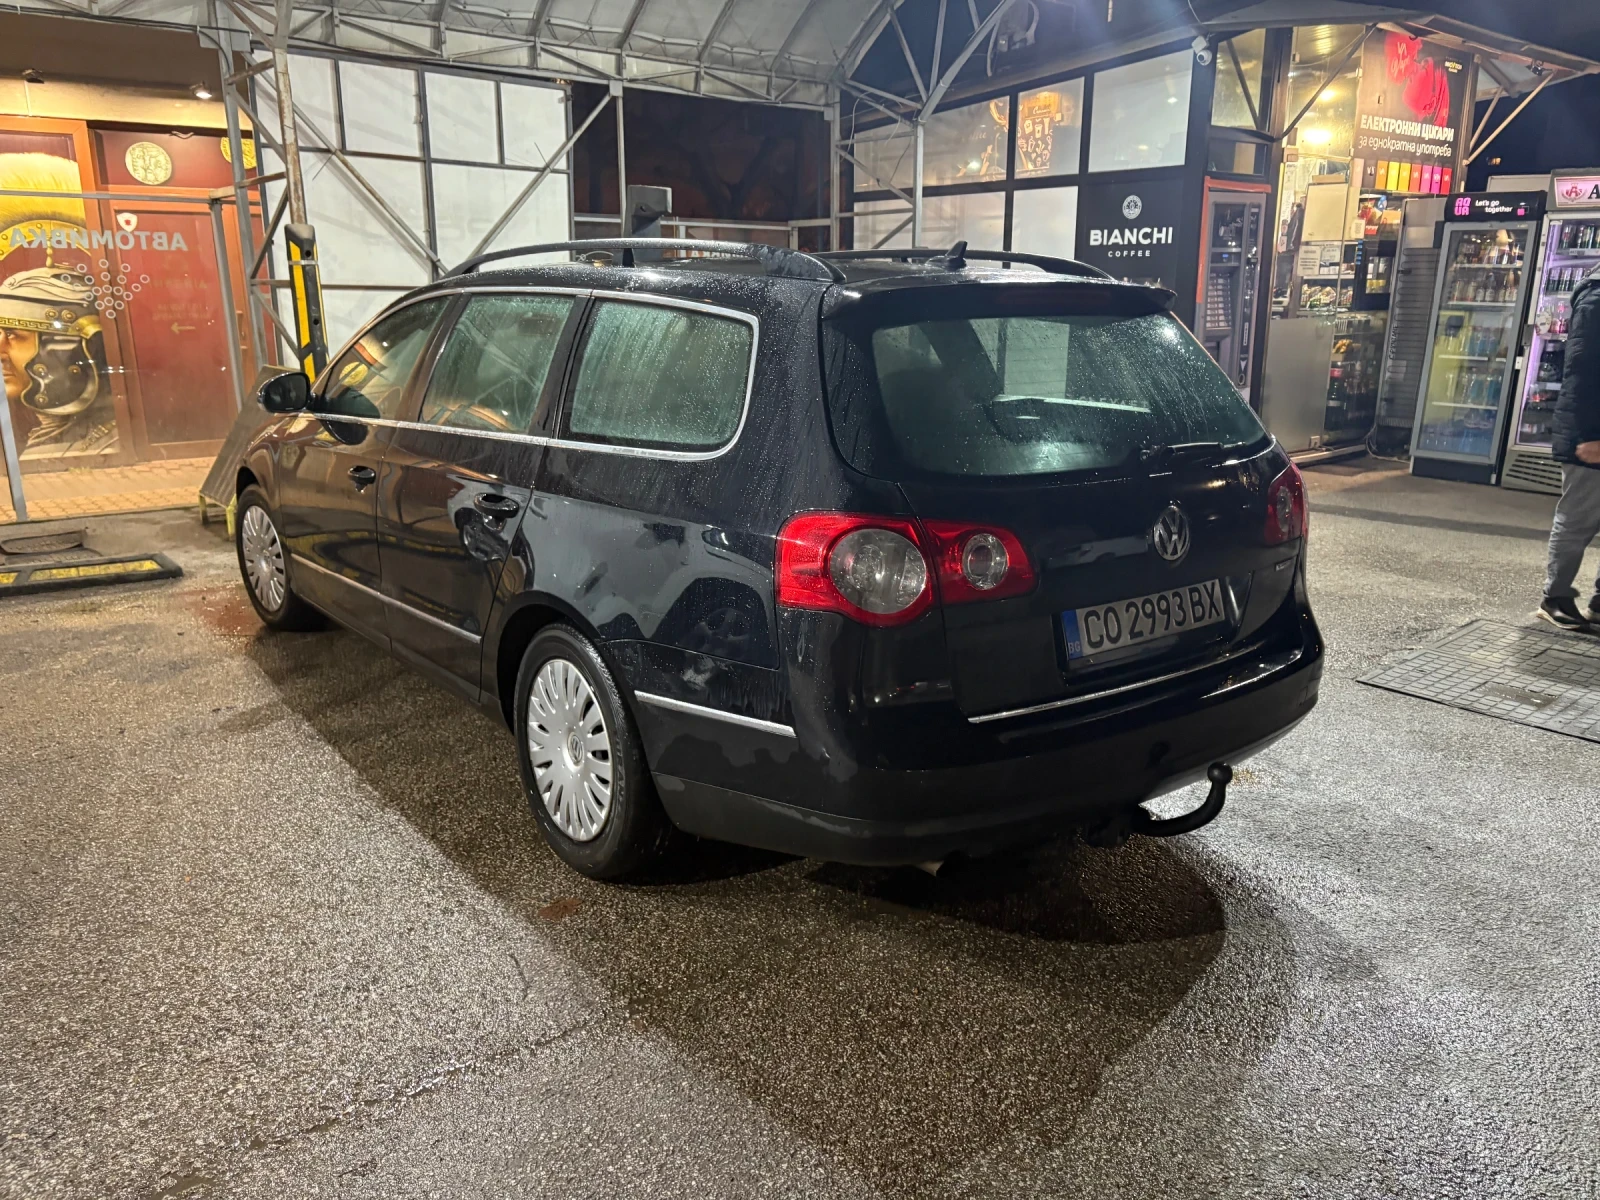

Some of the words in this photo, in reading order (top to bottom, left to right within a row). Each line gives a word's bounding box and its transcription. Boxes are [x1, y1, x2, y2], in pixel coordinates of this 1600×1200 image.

[1360, 114, 1421, 137] ЕЛЕКТРОННИ
[1421, 123, 1455, 142] ЦИГАРИ
[1358, 135, 1368, 148] за
[1368, 136, 1416, 152] еднократна
[1416, 143, 1452, 157] употреба
[1485, 205, 1513, 214] together
[1089, 226, 1173, 246] BIANCHI
[1107, 249, 1151, 258] COFFEE
[1125, 591, 1187, 640] 2993
[1187, 582, 1221, 624] BX
[1067, 640, 1081, 653] BG
